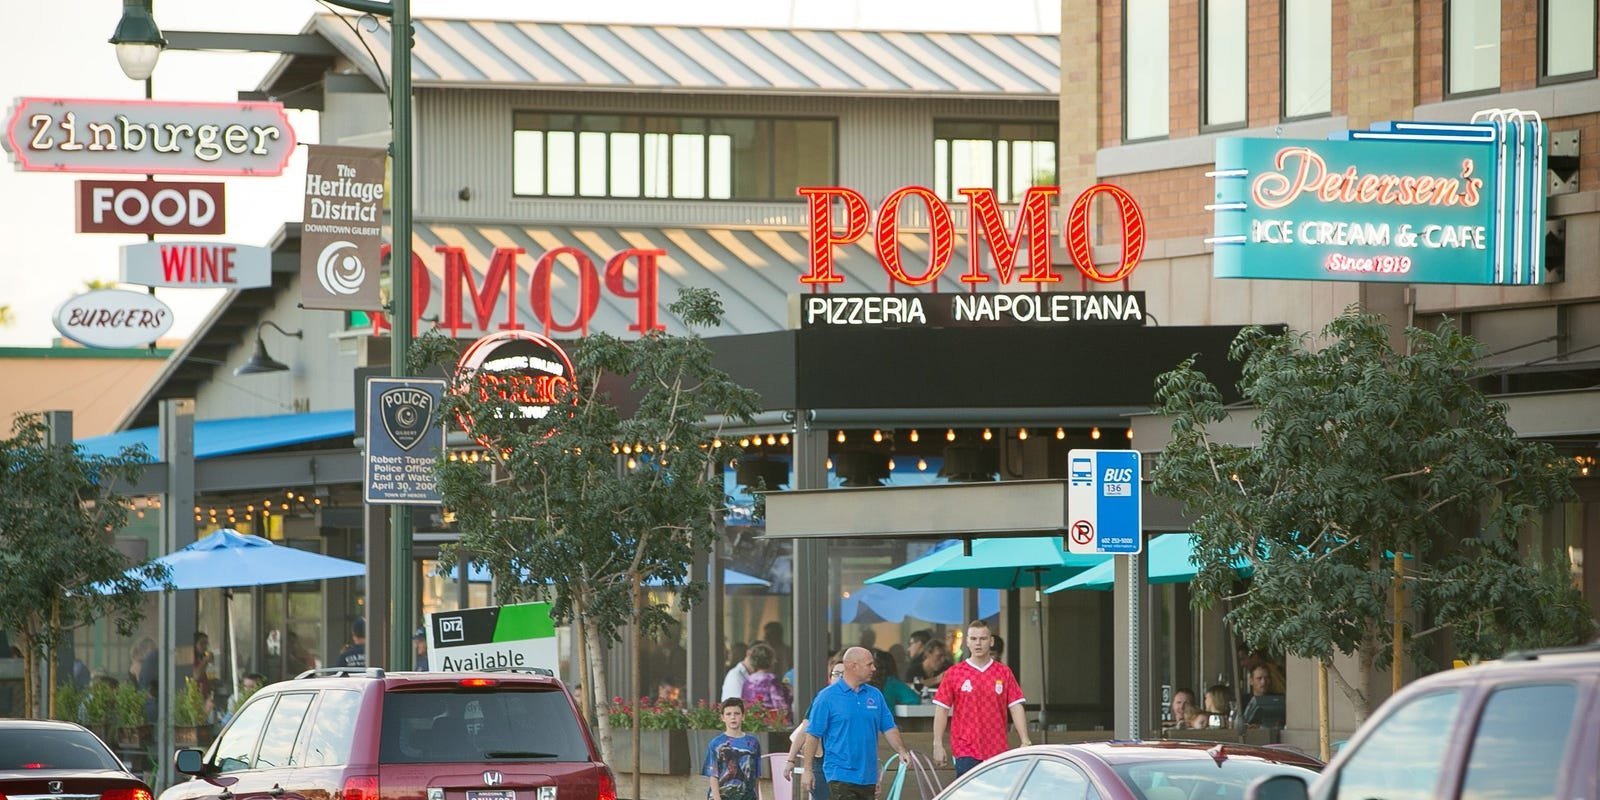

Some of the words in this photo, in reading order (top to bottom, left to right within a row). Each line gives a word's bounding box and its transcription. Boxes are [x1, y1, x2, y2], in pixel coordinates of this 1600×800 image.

[30, 111, 279, 161] Zinburger
[337, 164, 356, 177] The
[1252, 146, 1483, 210] Petersen's
[306, 173, 384, 203] Heritage
[93, 187, 216, 227] FOOD
[311, 197, 377, 222] District
[305, 224, 351, 235] DOWNTOWN
[352, 226, 380, 236] GILBERT
[797, 184, 1146, 286] POMO
[1252, 219, 1294, 244] ICE
[1298, 220, 1391, 247] CREAM
[1394, 223, 1418, 248] &
[1422, 224, 1486, 250] CAFE
[160, 245, 238, 284] WINE
[1326, 252, 1373, 272] Since
[1373, 255, 1411, 274] 1919
[68, 308, 165, 329] BURGERS
[808, 297, 927, 325] PIZZERIA
[955, 293, 1143, 323] NAPOLETANA
[385, 391, 429, 409] POLICE
[370, 455, 402, 464] Robert
[405, 456, 437, 466] Targos
[374, 464, 402, 472] Police
[405, 464, 432, 474] Offic
[374, 473, 392, 481] End
[395, 473, 405, 481] of
[407, 473, 436, 482] Watc
[1104, 468, 1133, 482] BUS
[371, 482, 394, 491] April
[397, 482, 412, 492] 30,
[1106, 484, 1122, 492] 136
[443, 621, 462, 632] DTZ
[442, 649, 525, 673] Available
[961, 679, 973, 692] 4
